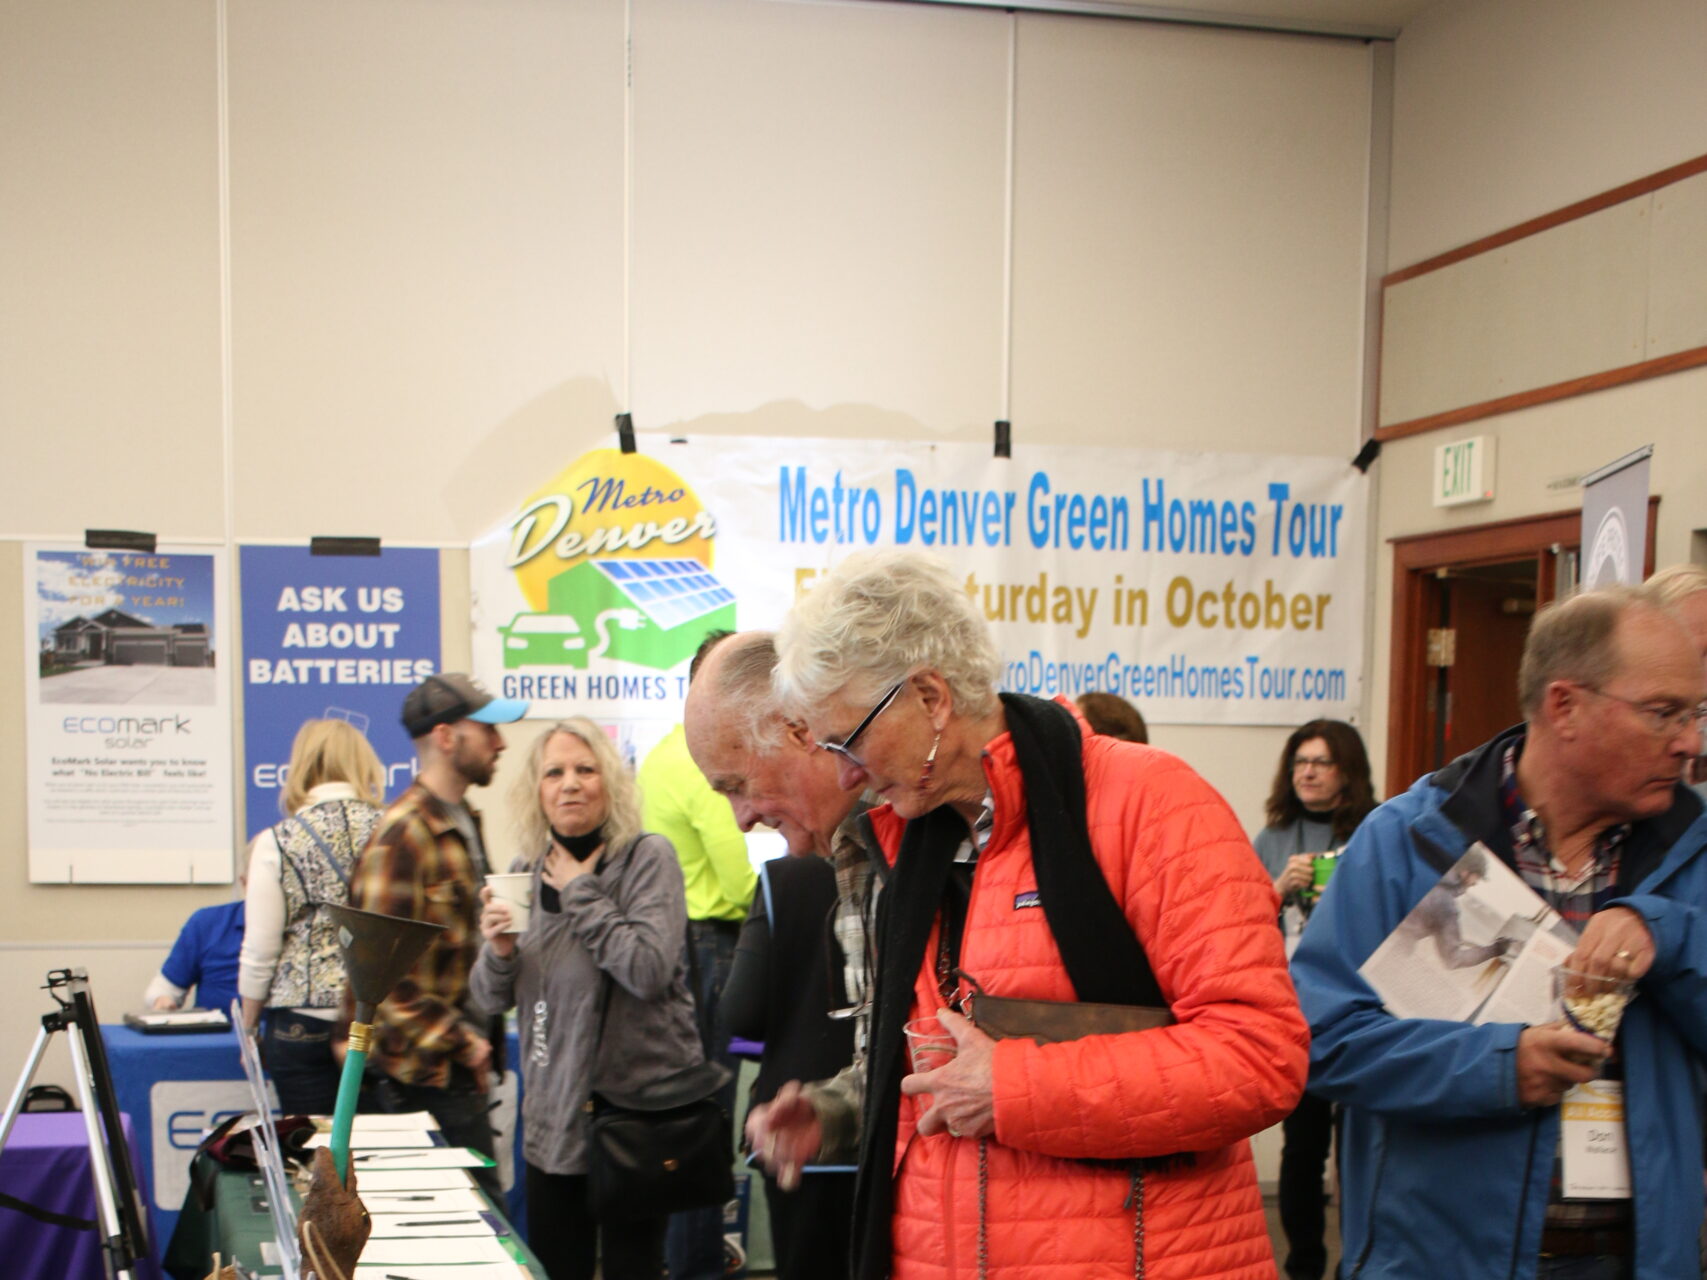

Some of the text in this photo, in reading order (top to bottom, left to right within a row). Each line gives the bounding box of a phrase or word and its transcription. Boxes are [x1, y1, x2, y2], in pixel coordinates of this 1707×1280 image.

[1443, 441, 1474, 498] EXIT
[576, 477, 686, 515] Metro
[779, 466, 1343, 558] Metro Denver Green Homes Tour
[506, 494, 717, 569] Denver
[124, 557, 170, 569] FREE
[68, 576, 186, 588] ELECTRICITY
[131, 596, 185, 608] YEAR!
[277, 586, 404, 613] ASK US
[964, 572, 1332, 639] turday in October
[282, 622, 401, 649] ABOUT
[249, 659, 434, 684] BATTERIES
[503, 675, 577, 700] GREEN
[588, 676, 667, 700] HOMES
[105, 737, 154, 750] solar
